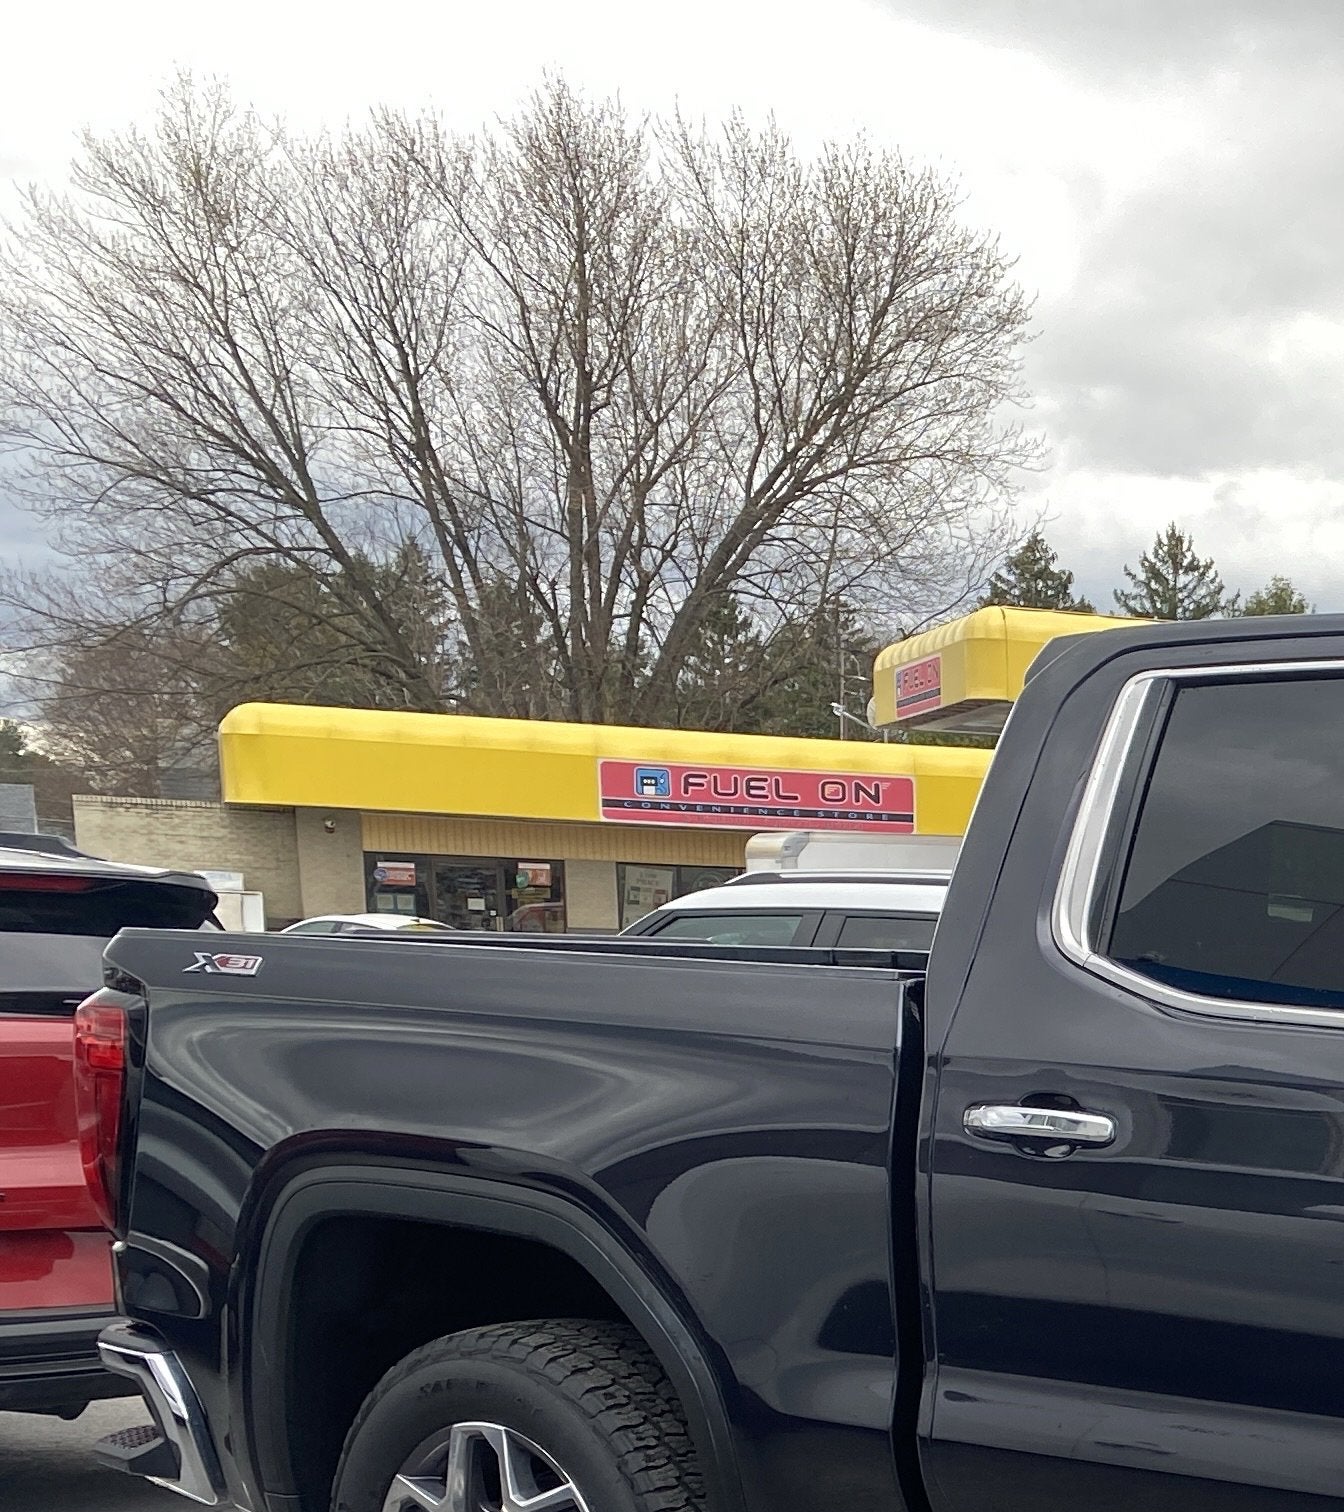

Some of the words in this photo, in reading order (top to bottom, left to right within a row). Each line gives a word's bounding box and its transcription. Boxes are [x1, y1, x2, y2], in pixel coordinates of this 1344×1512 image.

[682, 773, 800, 802] FUEL
[820, 780, 881, 805] ON
[623, 800, 800, 817] CONVENIENCE
[816, 810, 889, 821] STORE
[182, 951, 263, 976] X31
